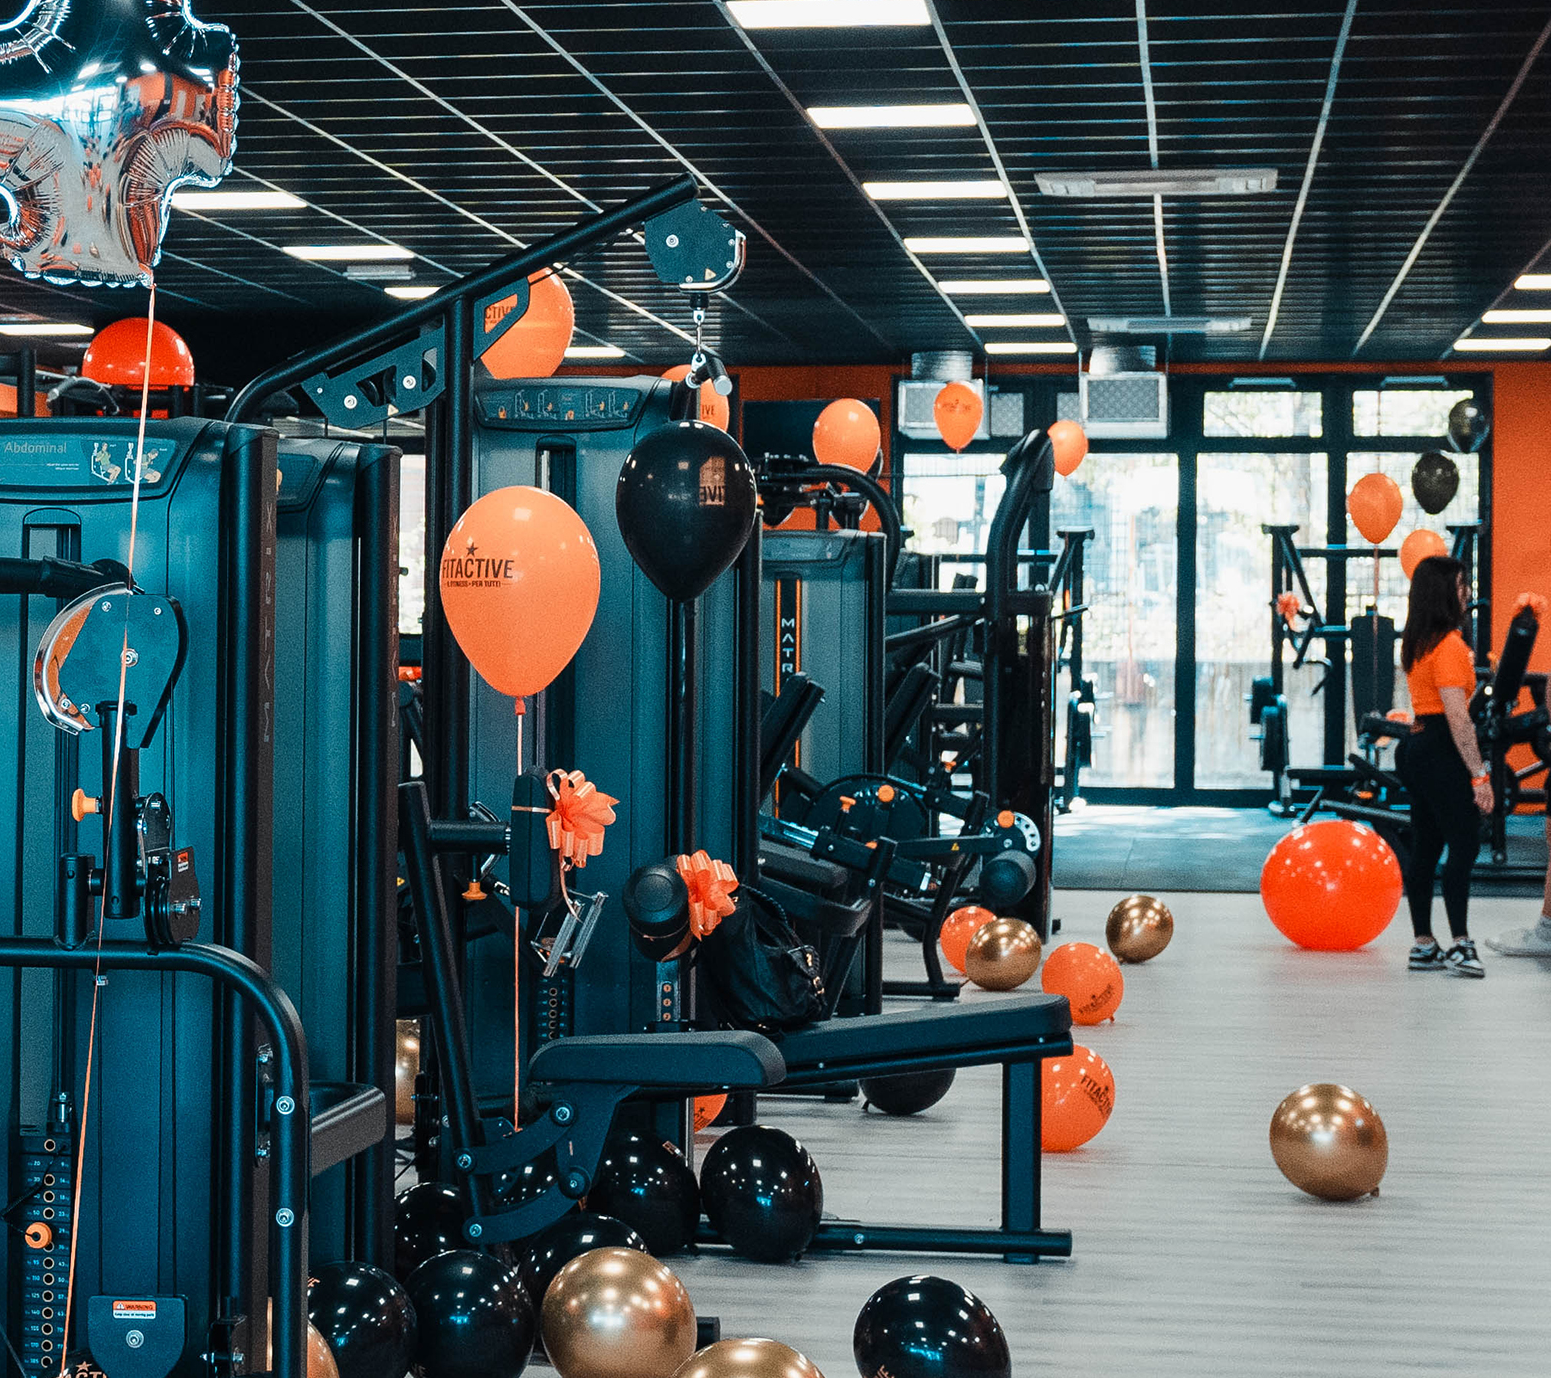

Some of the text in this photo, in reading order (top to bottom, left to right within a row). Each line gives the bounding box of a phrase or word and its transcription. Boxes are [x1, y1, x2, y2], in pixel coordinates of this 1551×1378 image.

[4, 441, 67, 454] Abdominal
[442, 558, 515, 580] FITACTIVE
[781, 617, 795, 674] MATR
